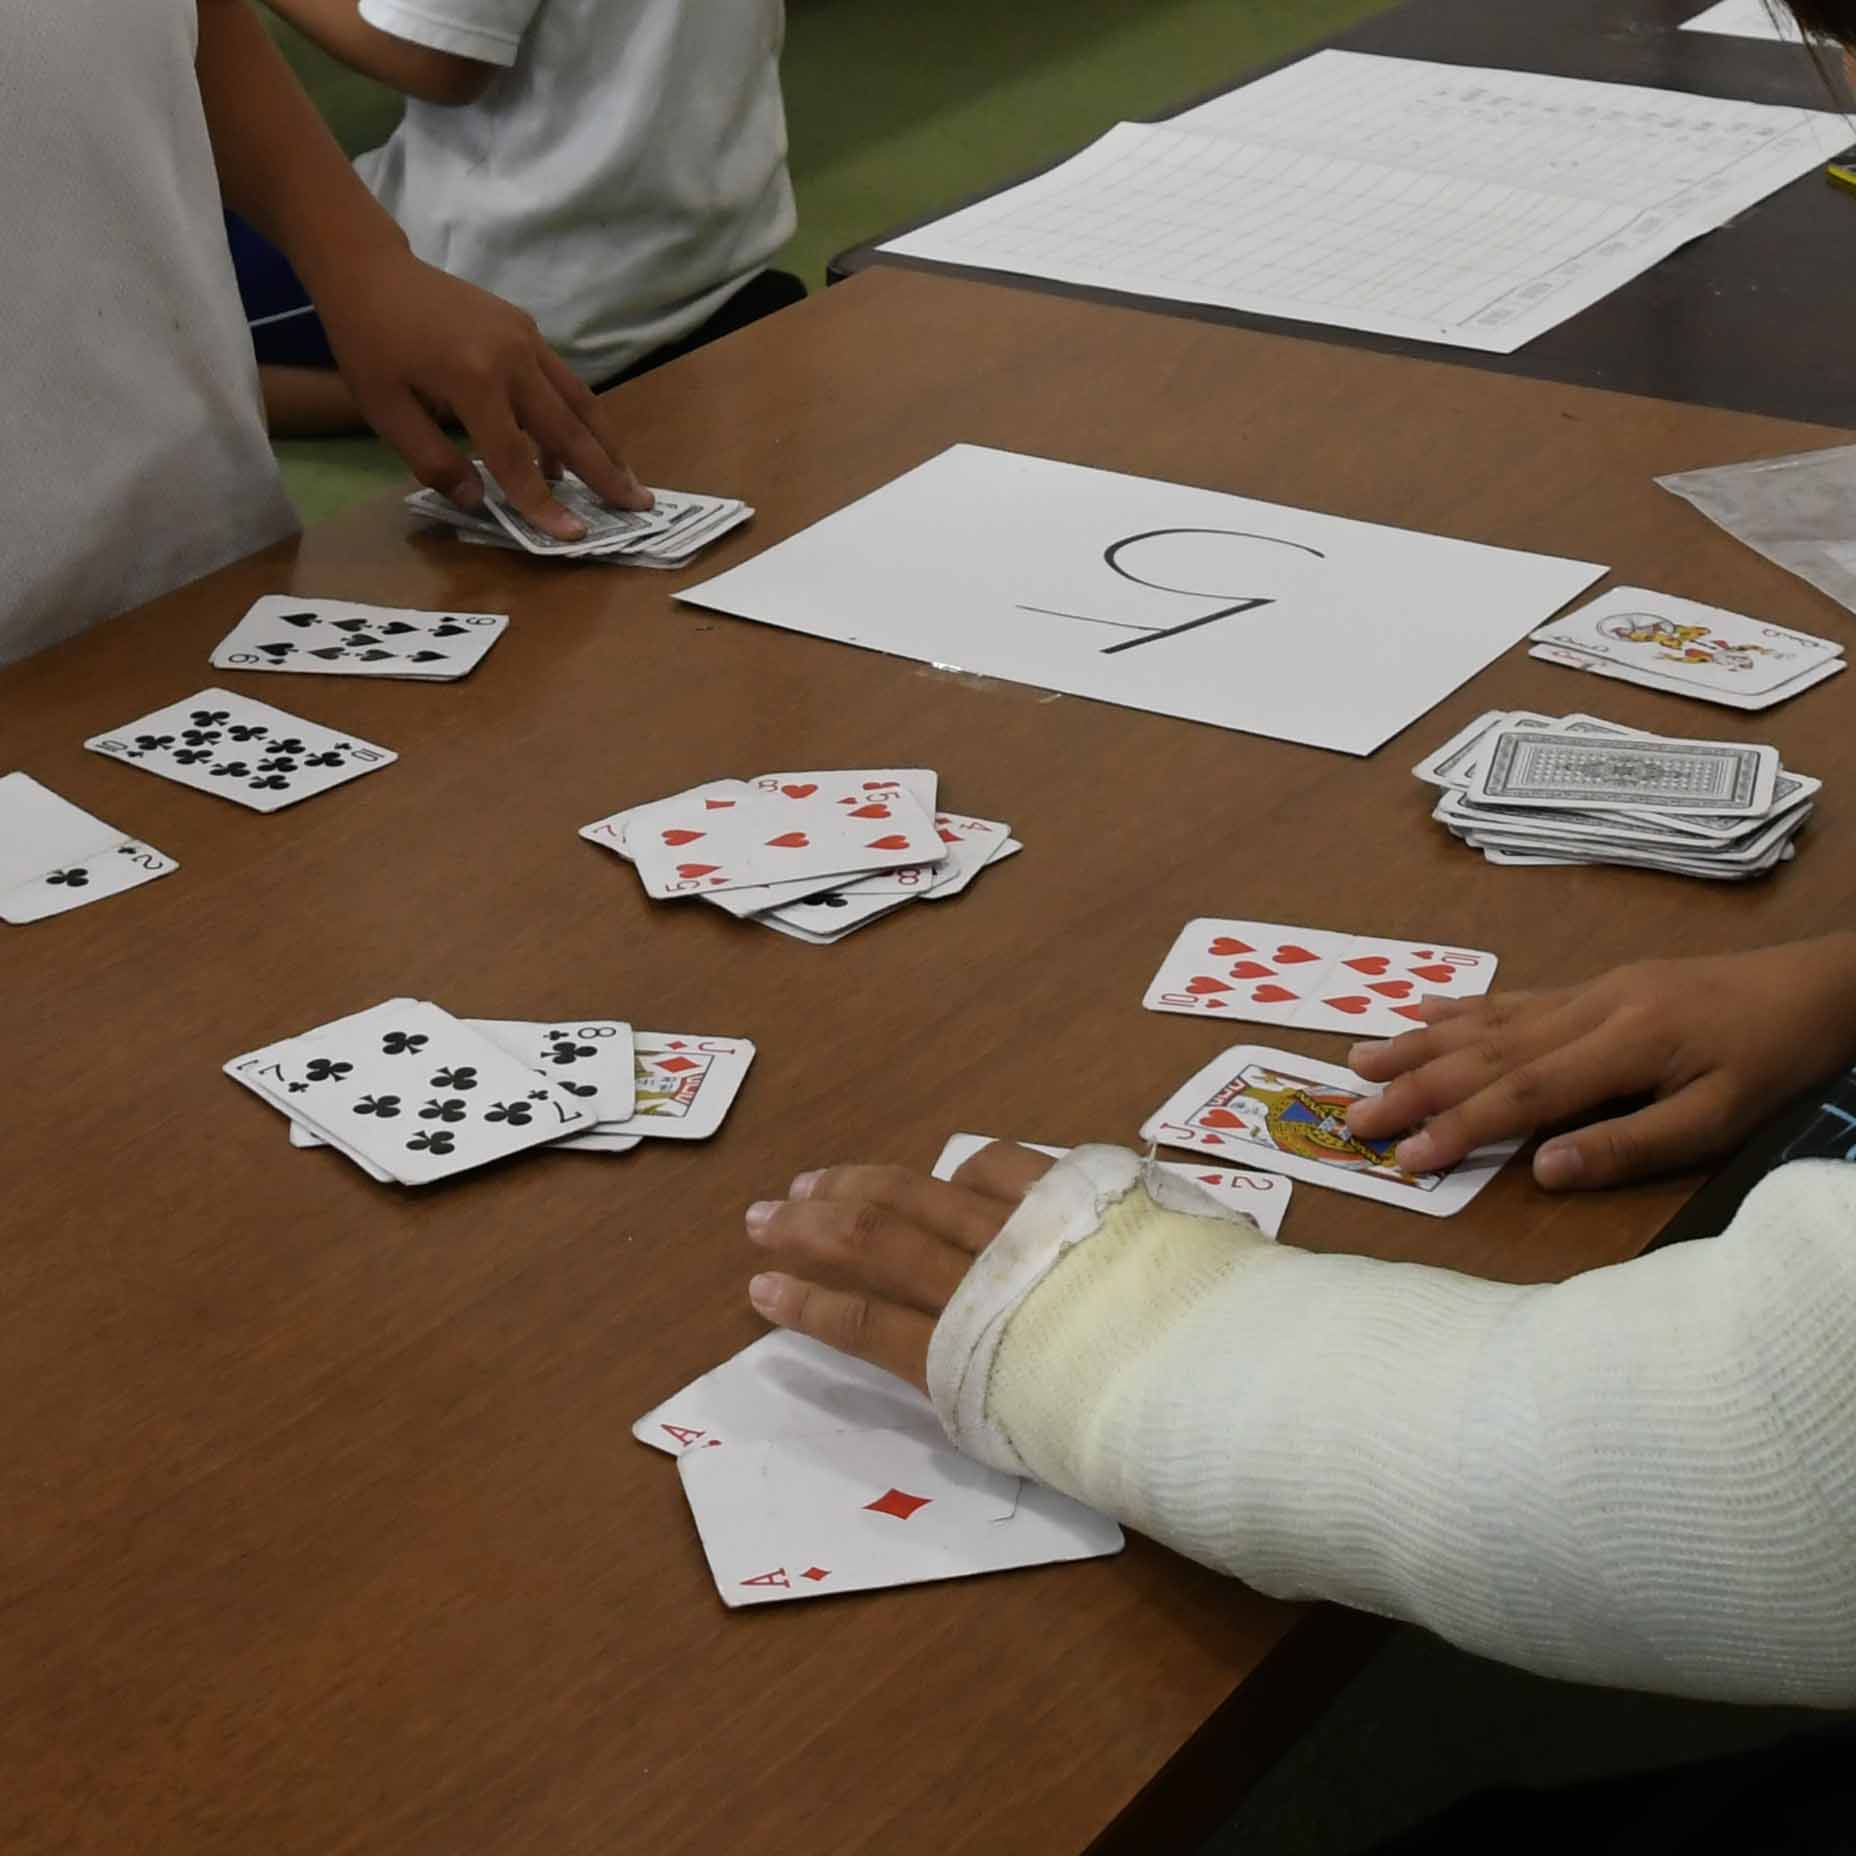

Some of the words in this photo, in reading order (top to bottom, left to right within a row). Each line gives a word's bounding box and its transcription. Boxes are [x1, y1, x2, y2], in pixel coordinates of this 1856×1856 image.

[1014, 527, 1326, 655] 5
[352, 748, 386, 764] 10
[866, 791, 901, 803] 5
[959, 822, 993, 833] 4
[134, 854, 164, 871] 2
[664, 879, 701, 893] 5
[1440, 950, 1482, 968] 10
[1157, 992, 1201, 1008] 10
[577, 1026, 617, 1040] 8
[697, 1041, 737, 1056] J
[258, 1063, 285, 1082] 7
[553, 1101, 583, 1124] 7
[1158, 1122, 1197, 1141] J
[1231, 1175, 1275, 1191] 2
[659, 1423, 707, 1448] A
[738, 1567, 791, 1589] A
